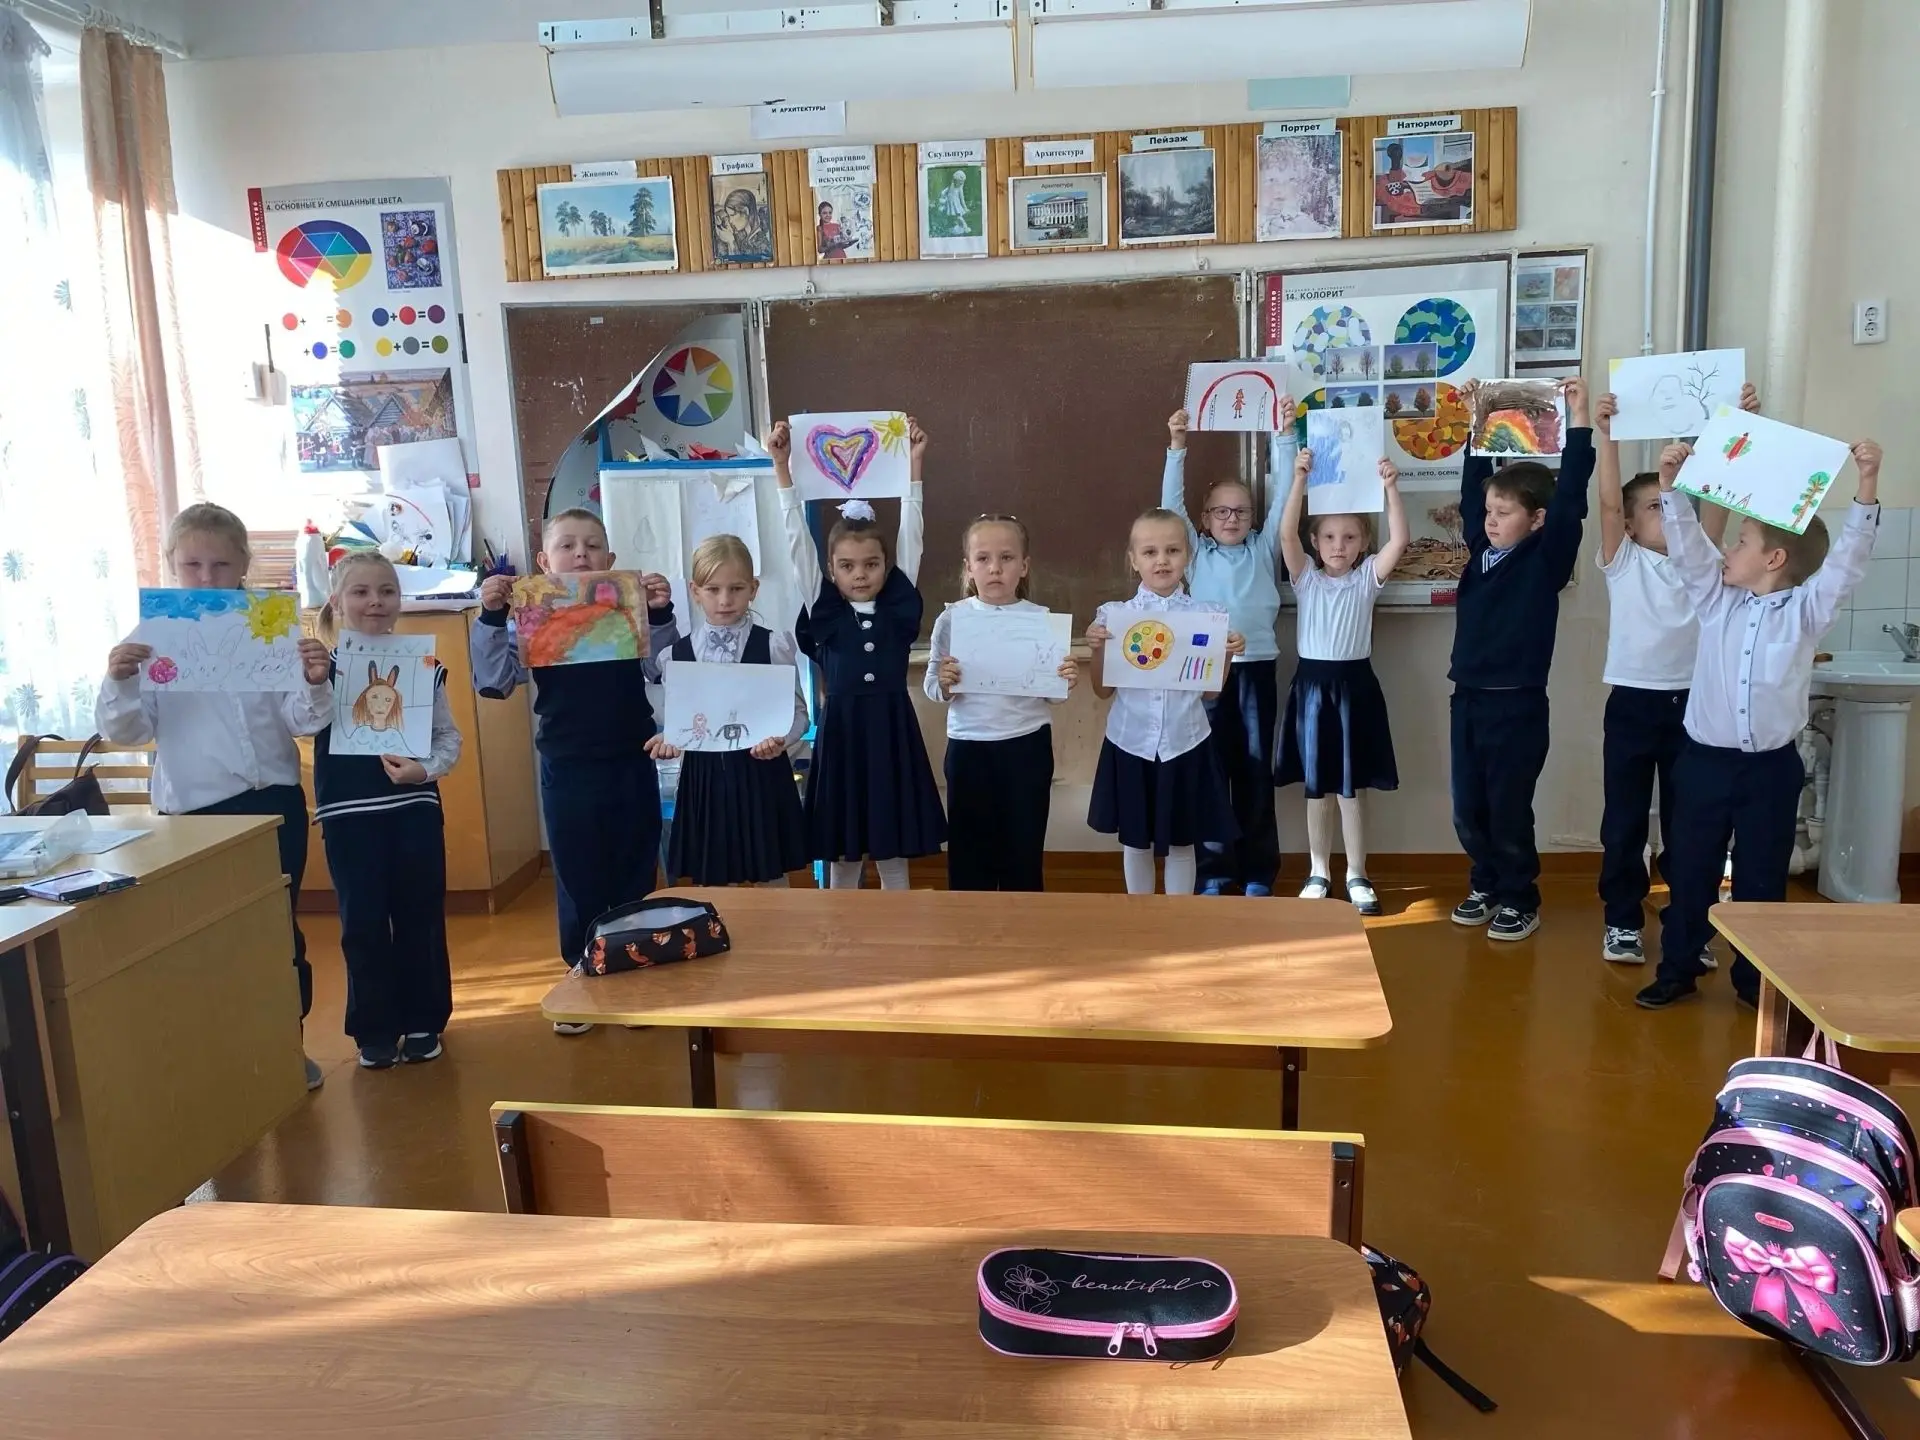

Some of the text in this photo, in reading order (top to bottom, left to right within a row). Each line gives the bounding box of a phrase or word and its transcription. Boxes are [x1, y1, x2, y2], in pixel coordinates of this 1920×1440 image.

[780, 105, 826, 113] АРХИТЕКТУРЫ
[1281, 123, 1320, 133] Портрет
[1397, 119, 1454, 129] Натюрморт
[1149, 135, 1188, 145] Пейзаж
[927, 150, 973, 159] Скульптура
[1034, 148, 1084, 158] Архитектура
[817, 154, 866, 164] Декоративно
[721, 161, 754, 171] Графика
[826, 165, 871, 174] прикладное
[582, 170, 619, 178] Живопись
[818, 176, 855, 184] искусство
[276, 203, 316, 211] ОСНОВНЫЕ
[325, 199, 375, 208] СМЕШАННЫЕ
[378, 196, 403, 204] ЦВЕТА
[1300, 290, 1344, 300] КОЛОРИТ
[1071, 1274, 1196, 1294] beautiful
